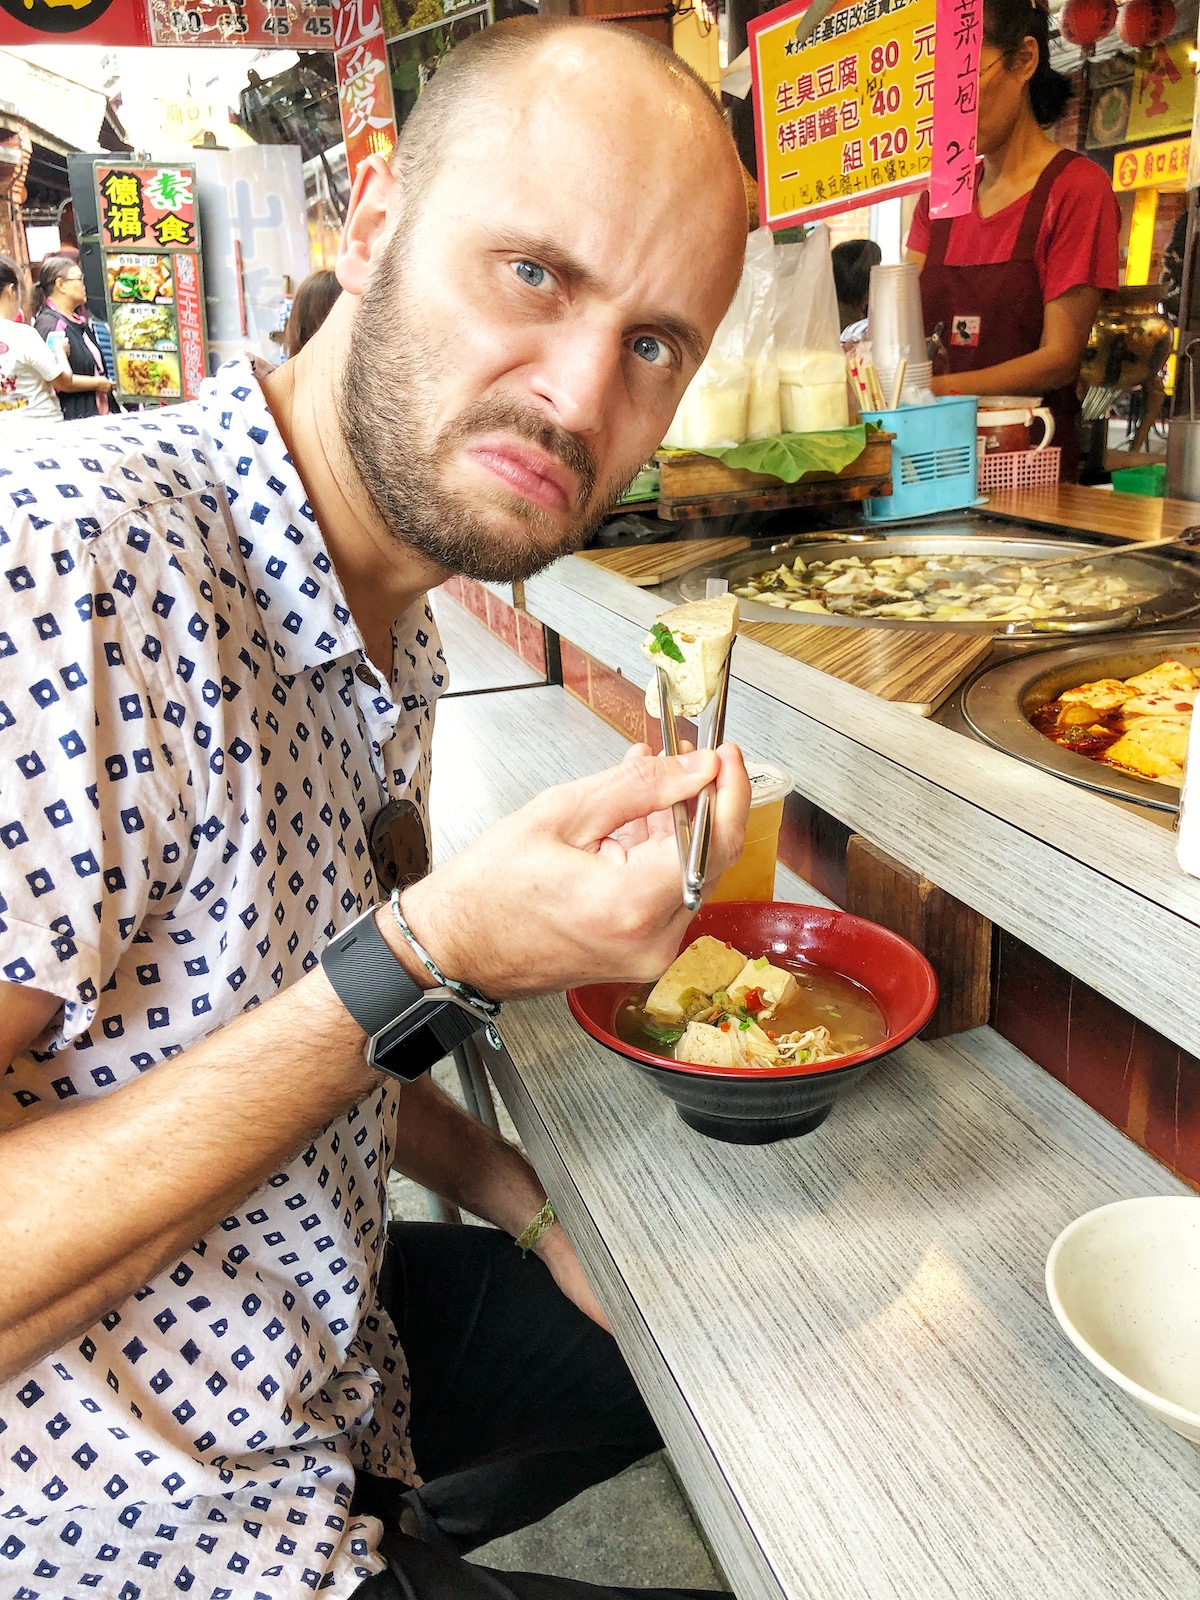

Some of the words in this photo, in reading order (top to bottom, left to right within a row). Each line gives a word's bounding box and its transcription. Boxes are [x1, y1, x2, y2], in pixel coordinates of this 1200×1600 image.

[265, 17, 289, 35] 45
[305, 17, 332, 36] 45
[776, 54, 858, 114] 生臭豆腐
[870, 40, 899, 75] 80
[914, 23, 936, 61] 元
[778, 100, 860, 154] 特調醬包
[872, 85, 900, 117] 40
[914, 71, 936, 106] 元
[842, 139, 864, 174] 組
[869, 127, 908, 162] 120
[915, 116, 935, 151] 元
[105, 174, 143, 238] 德福
[149, 172, 194, 207] 素
[153, 213, 191, 244] 食
